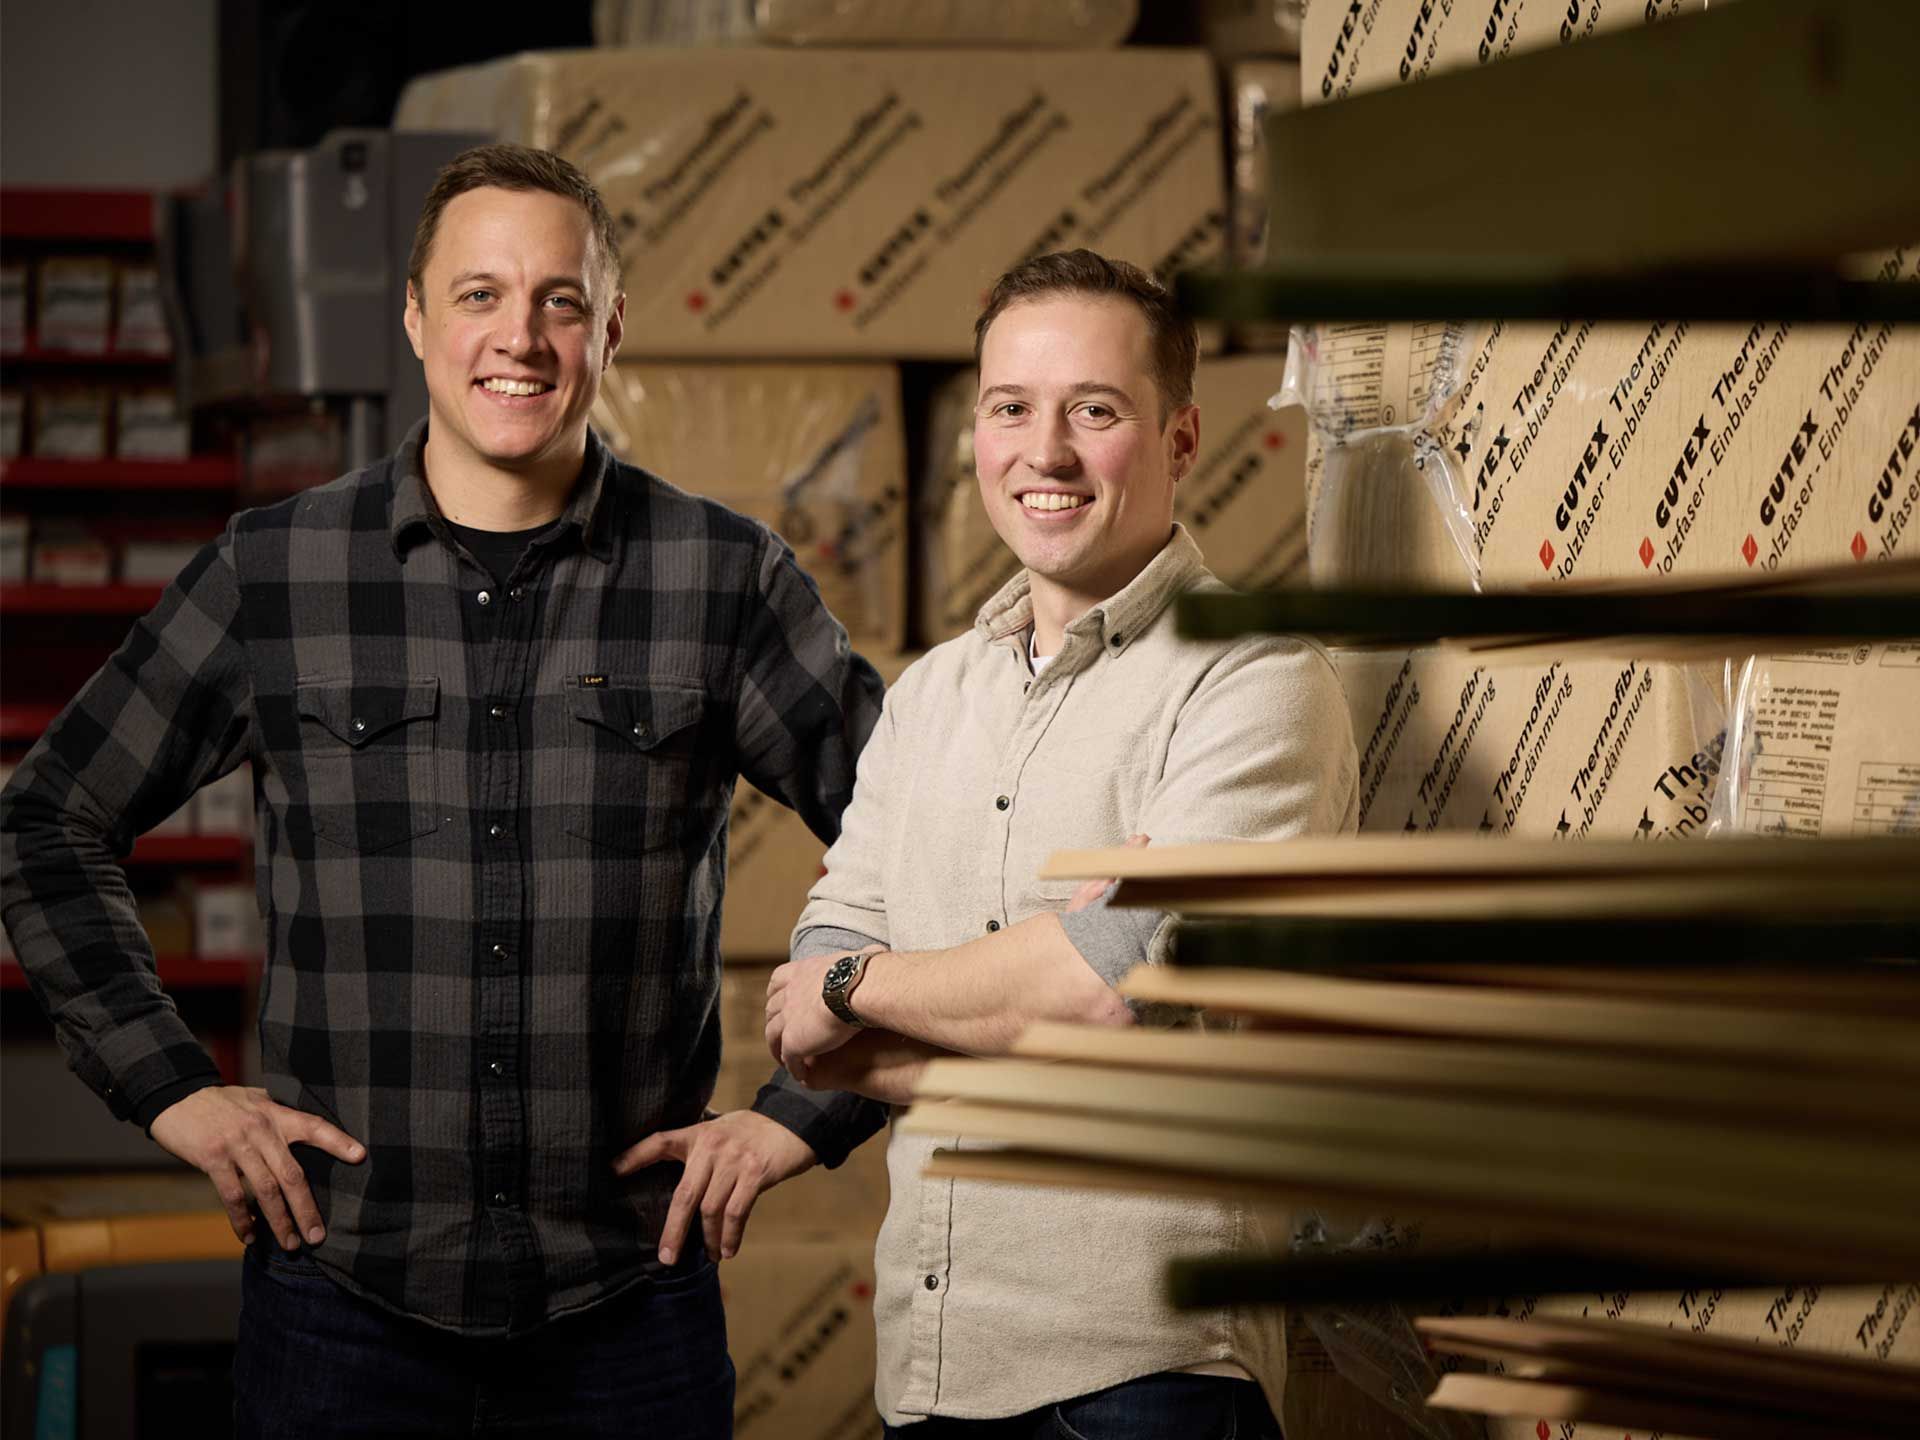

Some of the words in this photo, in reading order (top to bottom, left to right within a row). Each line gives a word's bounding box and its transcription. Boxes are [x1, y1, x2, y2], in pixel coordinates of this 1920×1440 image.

[1322, 0, 1363, 98] GUTEX
[1400, 0, 1437, 82] GUTE
[1560, 0, 1586, 45] GU
[1556, 418, 1609, 532] GUTEX
[1656, 413, 1712, 529] GUTEX
[1760, 408, 1820, 527] GUTEX
[1868, 402, 1920, 524] GUTEX
[1570, 658, 1641, 803] Thermofibr
